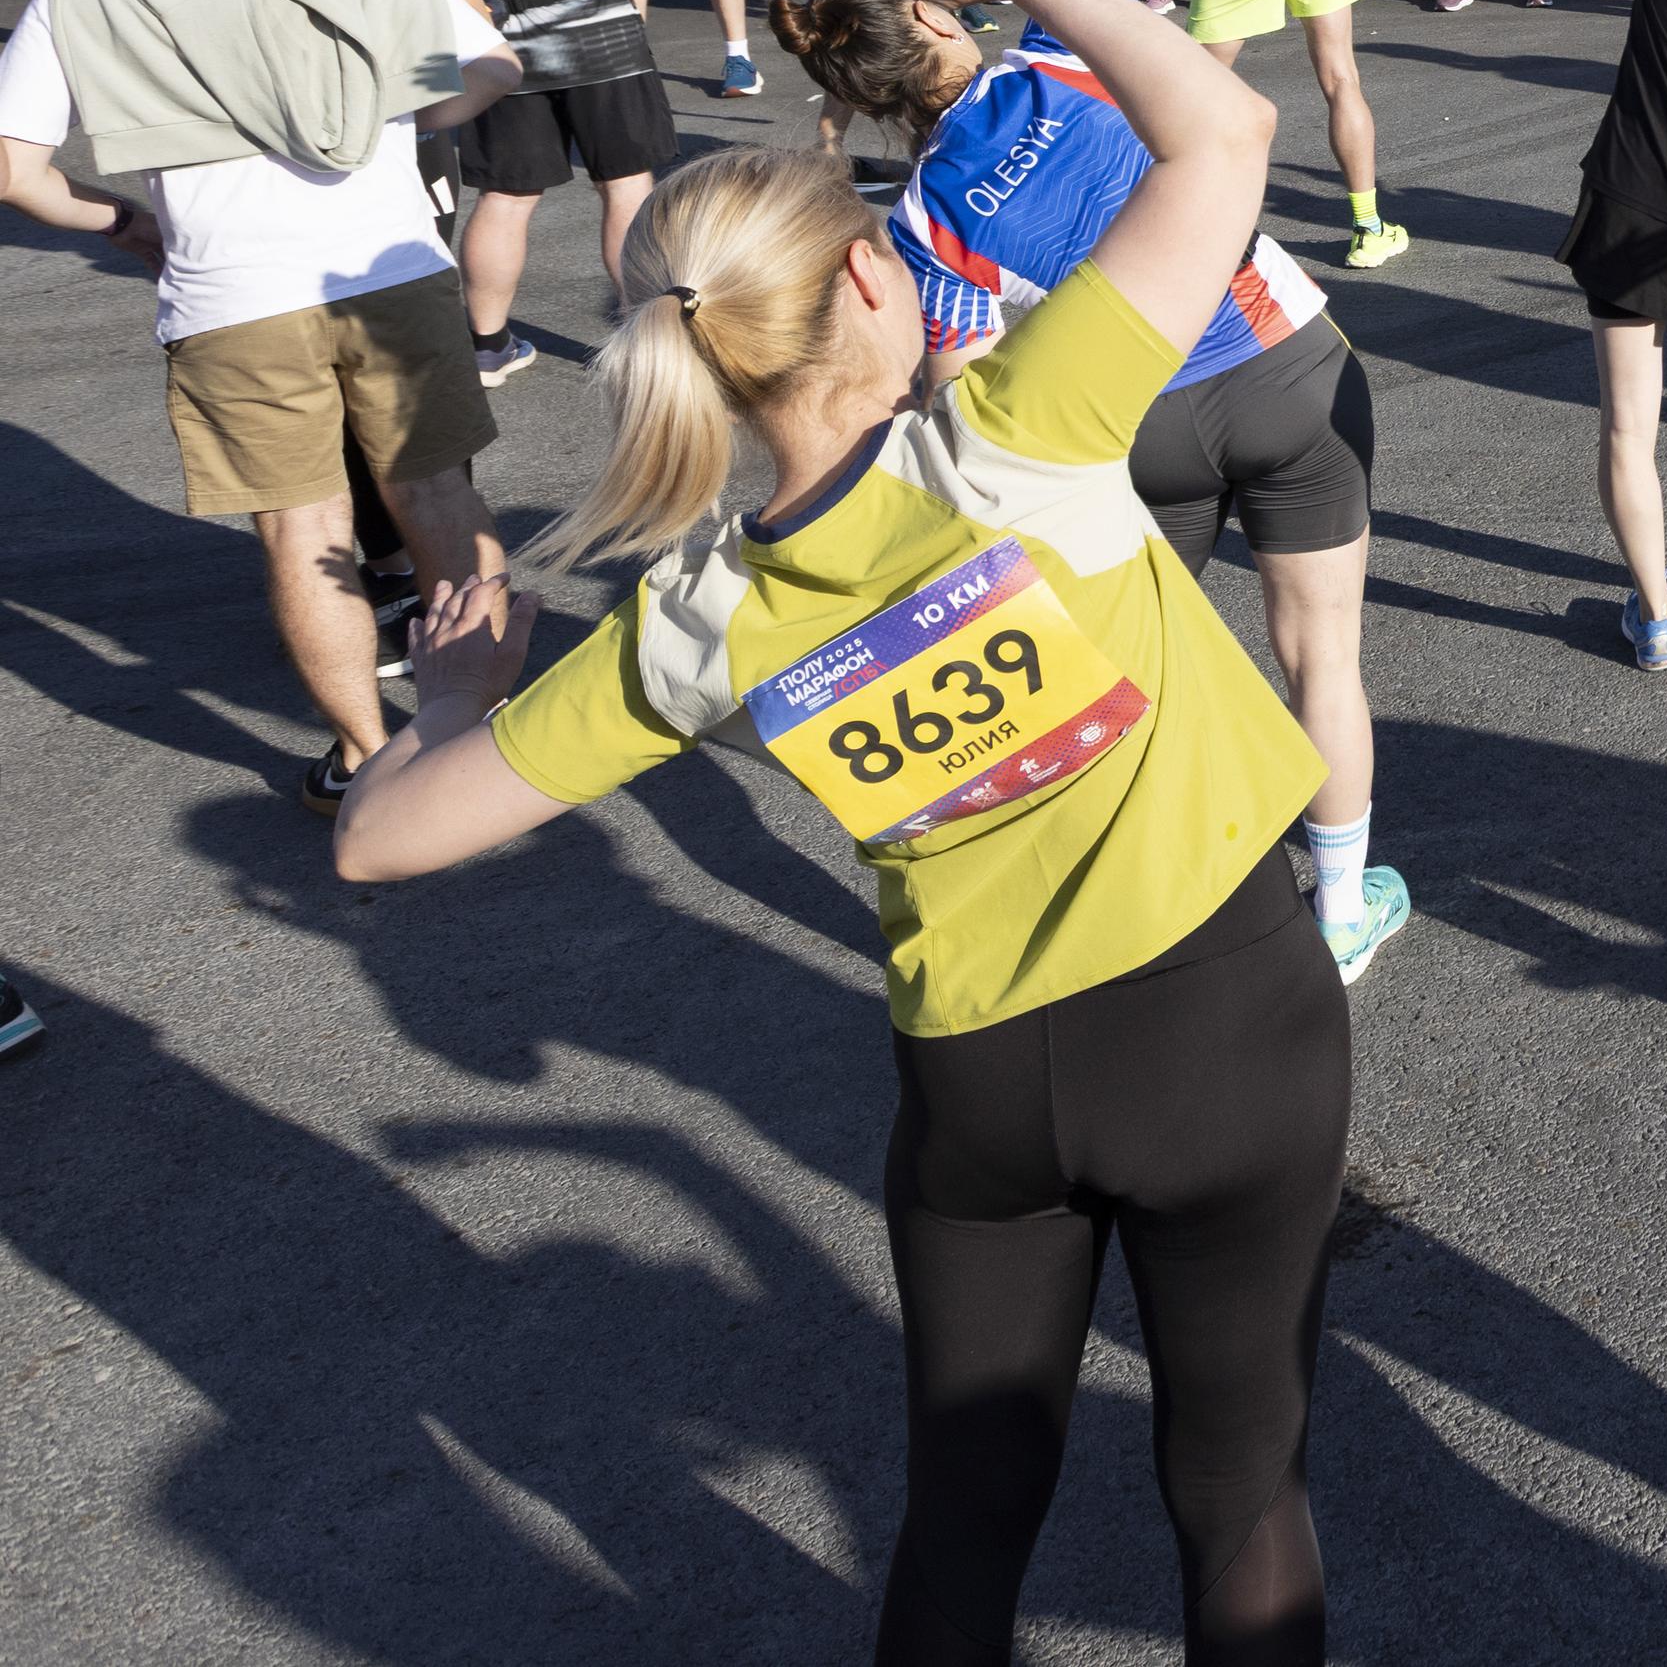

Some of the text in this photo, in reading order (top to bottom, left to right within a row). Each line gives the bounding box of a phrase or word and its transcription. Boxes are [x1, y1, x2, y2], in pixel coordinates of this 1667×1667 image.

[965, 116, 1064, 218] OLESYA
[911, 602, 944, 630] 10
[778, 637, 863, 693] ПОЛУ 2025
[785, 648, 875, 707] МАРАФОН
[828, 628, 1045, 784] 8639
[938, 719, 1021, 775] ЮЛИЯ
